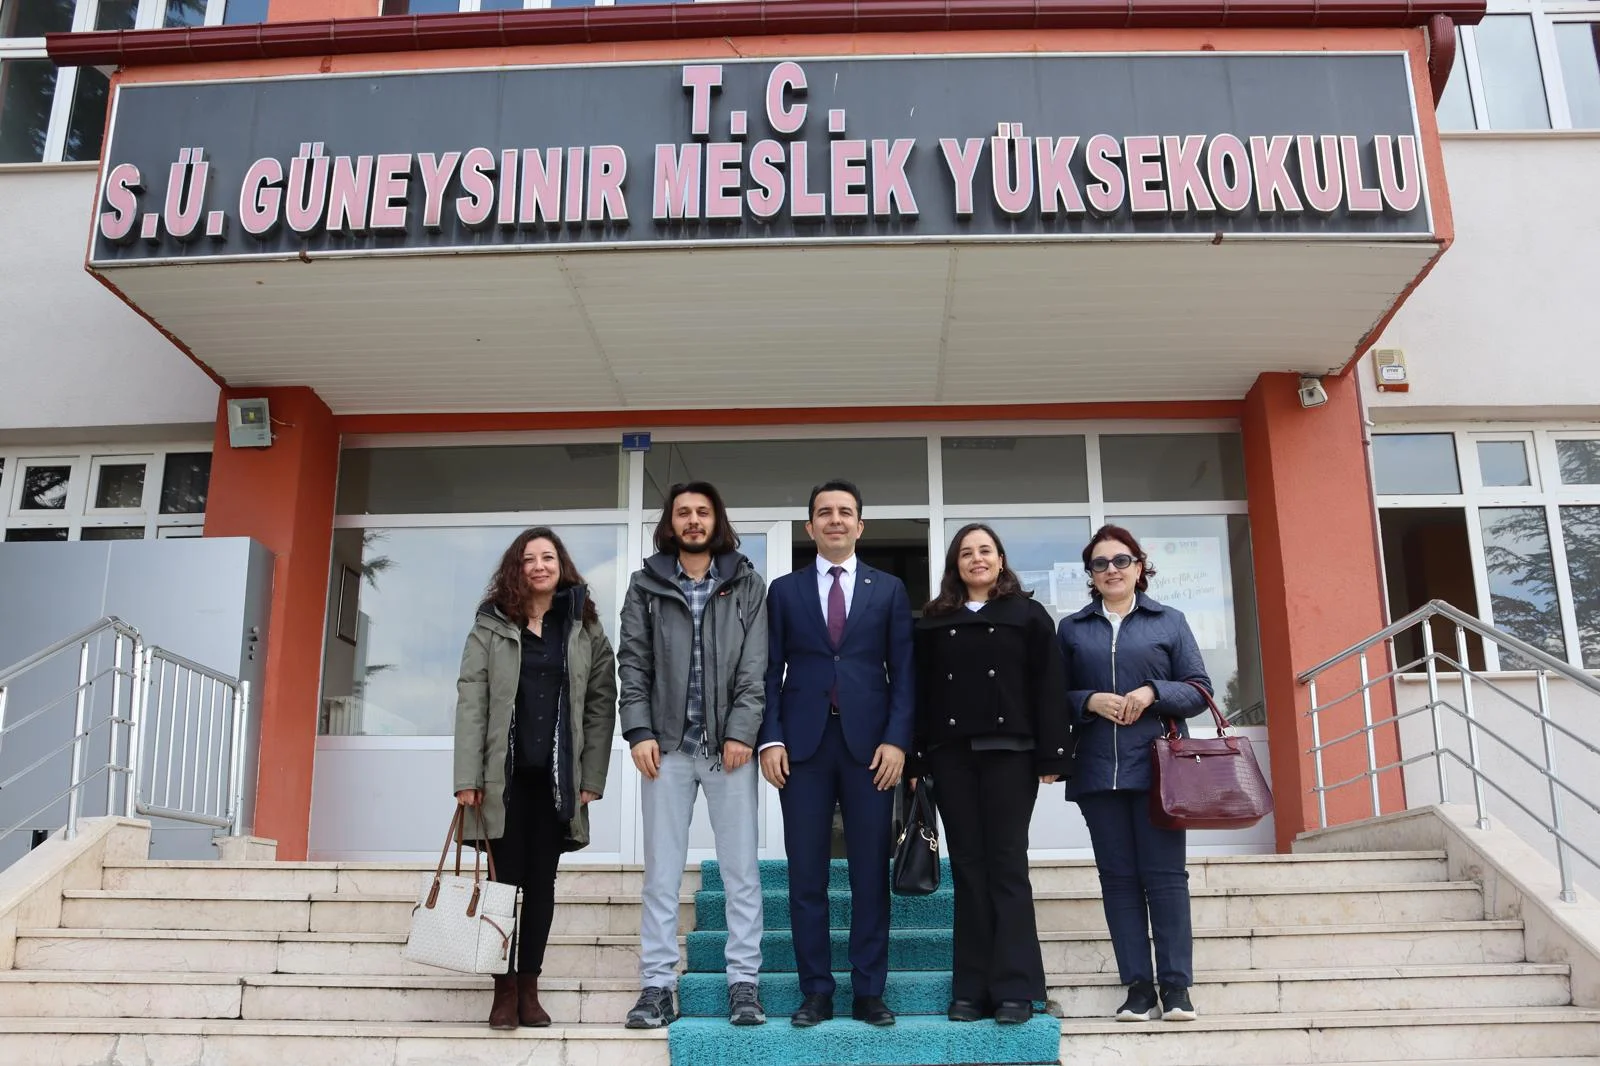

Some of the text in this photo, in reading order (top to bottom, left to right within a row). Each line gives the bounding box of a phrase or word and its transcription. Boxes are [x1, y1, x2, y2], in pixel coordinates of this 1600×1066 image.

[100, 122, 1421, 240] S.Ü. GÜNEYSINIR MESLEK YÜKSEKOKULU
[633, 436, 640, 447] 1
